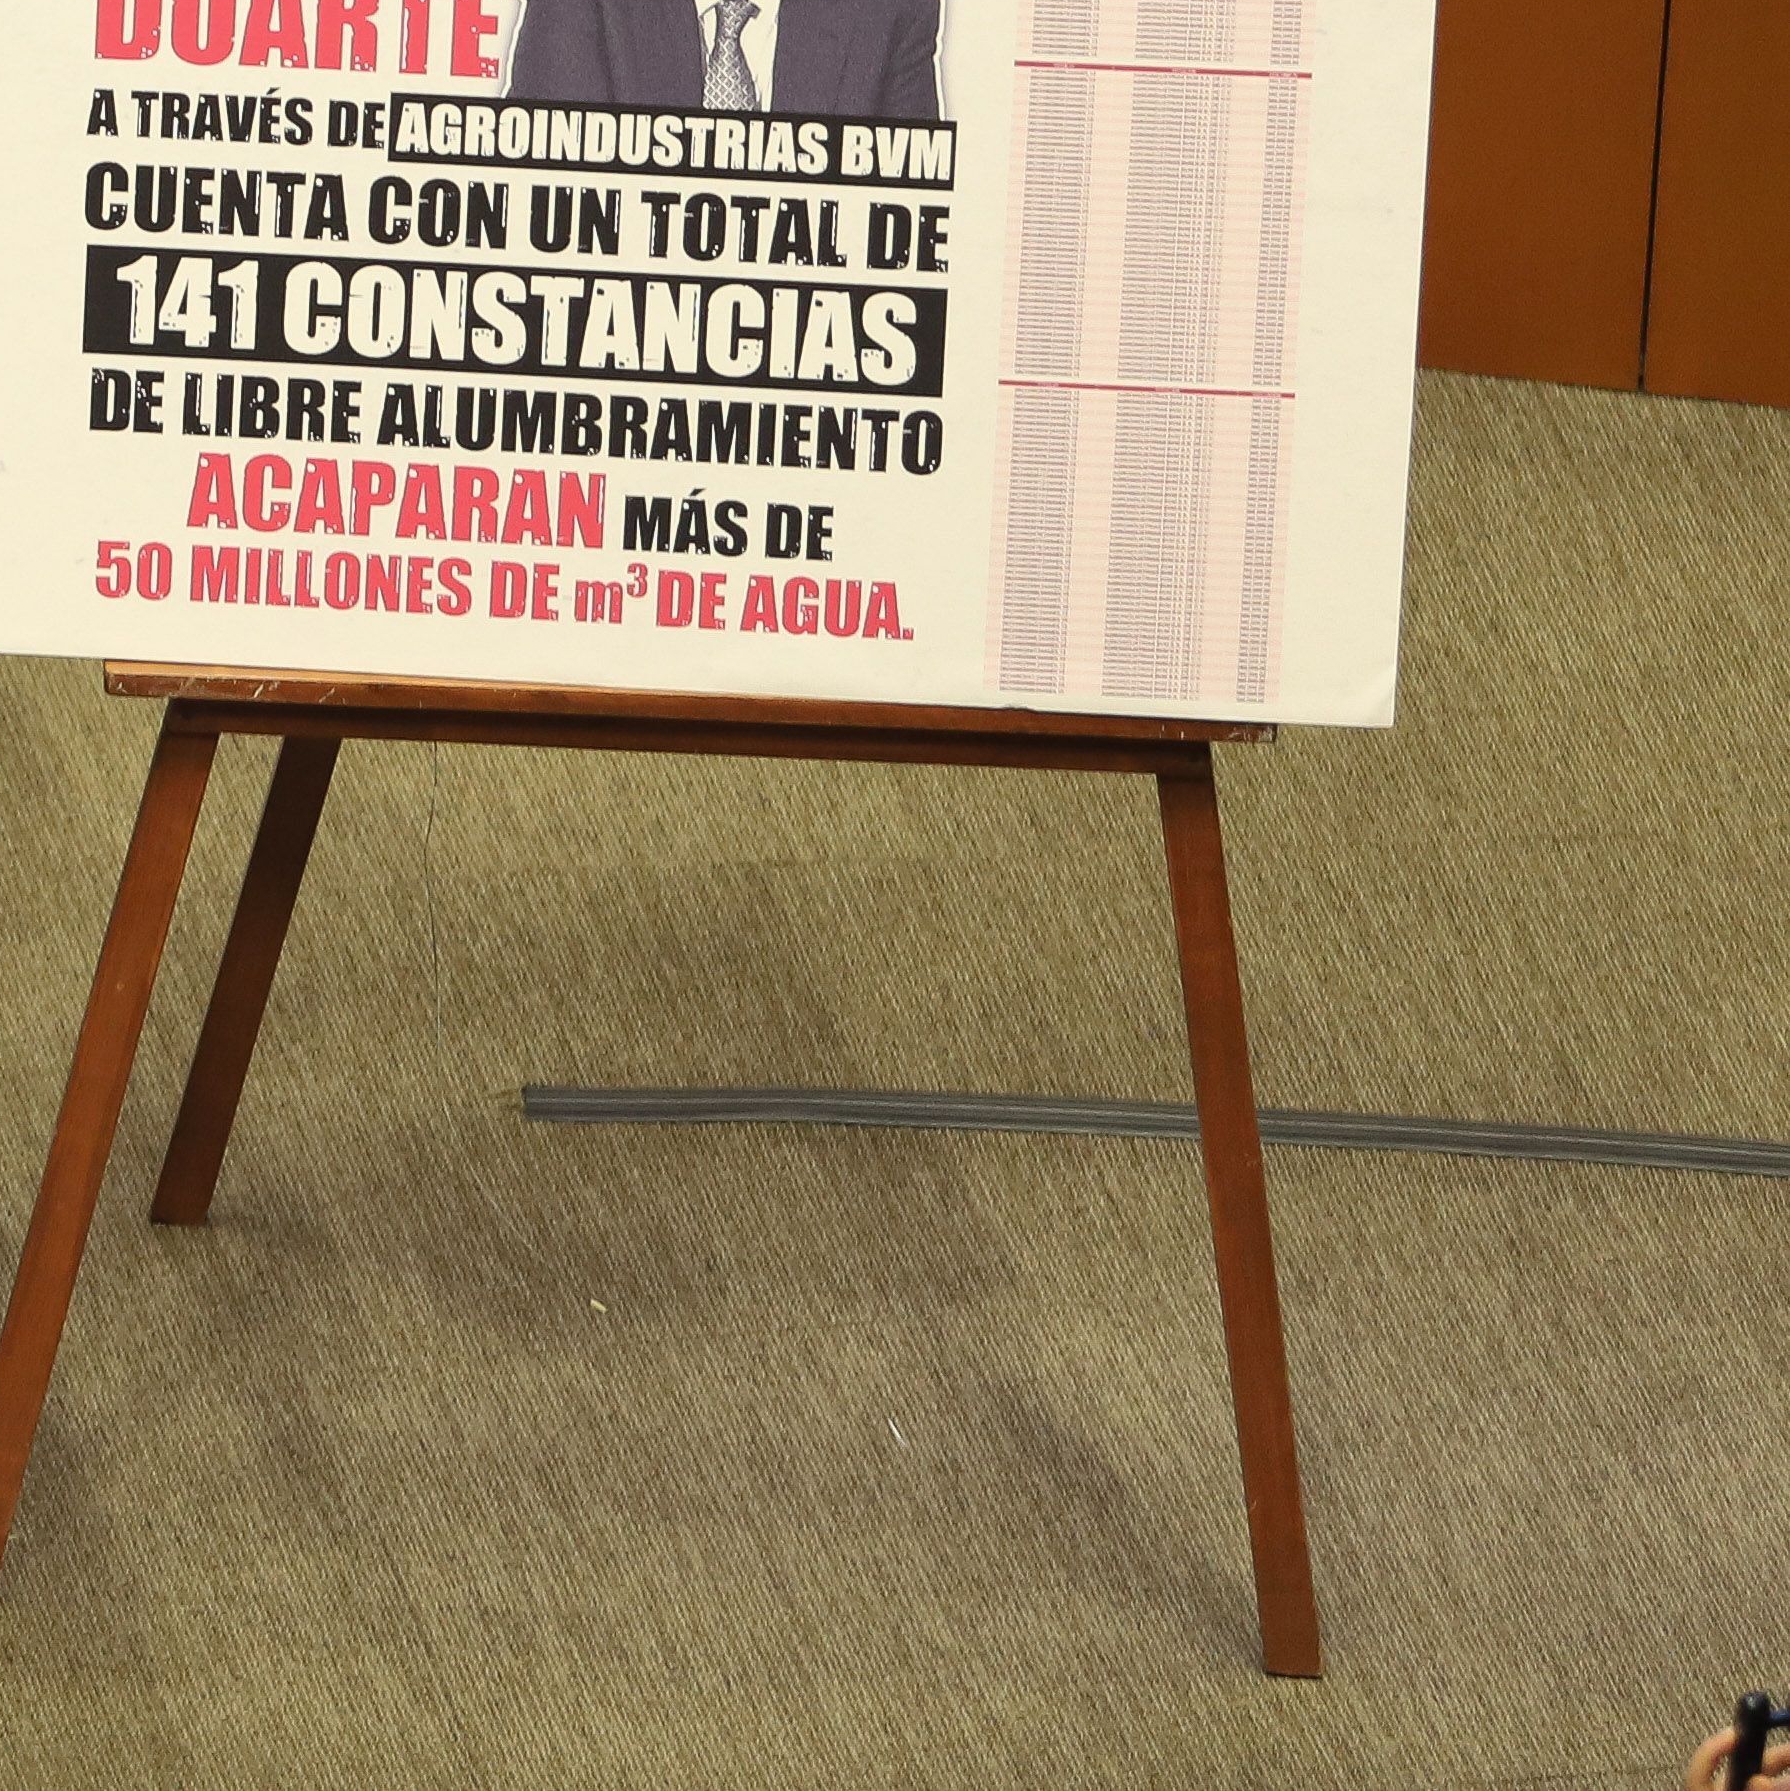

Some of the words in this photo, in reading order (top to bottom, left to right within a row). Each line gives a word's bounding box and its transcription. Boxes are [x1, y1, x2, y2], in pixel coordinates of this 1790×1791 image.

[86, 88, 119, 137] A
[130, 87, 313, 146] TRAVÉS
[327, 99, 385, 150] DE
[395, 101, 829, 175] AGROINDUSTRIAS
[840, 125, 953, 181] BVM
[84, 161, 350, 242] CUENTA
[367, 175, 509, 250] CON
[529, 184, 622, 256] UN
[641, 190, 848, 268] TOTAL
[866, 201, 950, 273] DE
[116, 254, 259, 350] 141
[283, 261, 917, 386] CONSTANCIAS
[89, 367, 165, 434] DE
[182, 372, 362, 444] LIBRE
[376, 382, 944, 476] ALUMBRAMIENTO
[186, 452, 607, 549] ACAPARAN
[622, 488, 748, 558] MÁS
[765, 503, 834, 562] DE
[95, 540, 173, 601] 50
[189, 544, 472, 617] MILLONES
[489, 559, 560, 621] DE
[656, 569, 728, 631] DE
[740, 574, 915, 641] AGUA.
